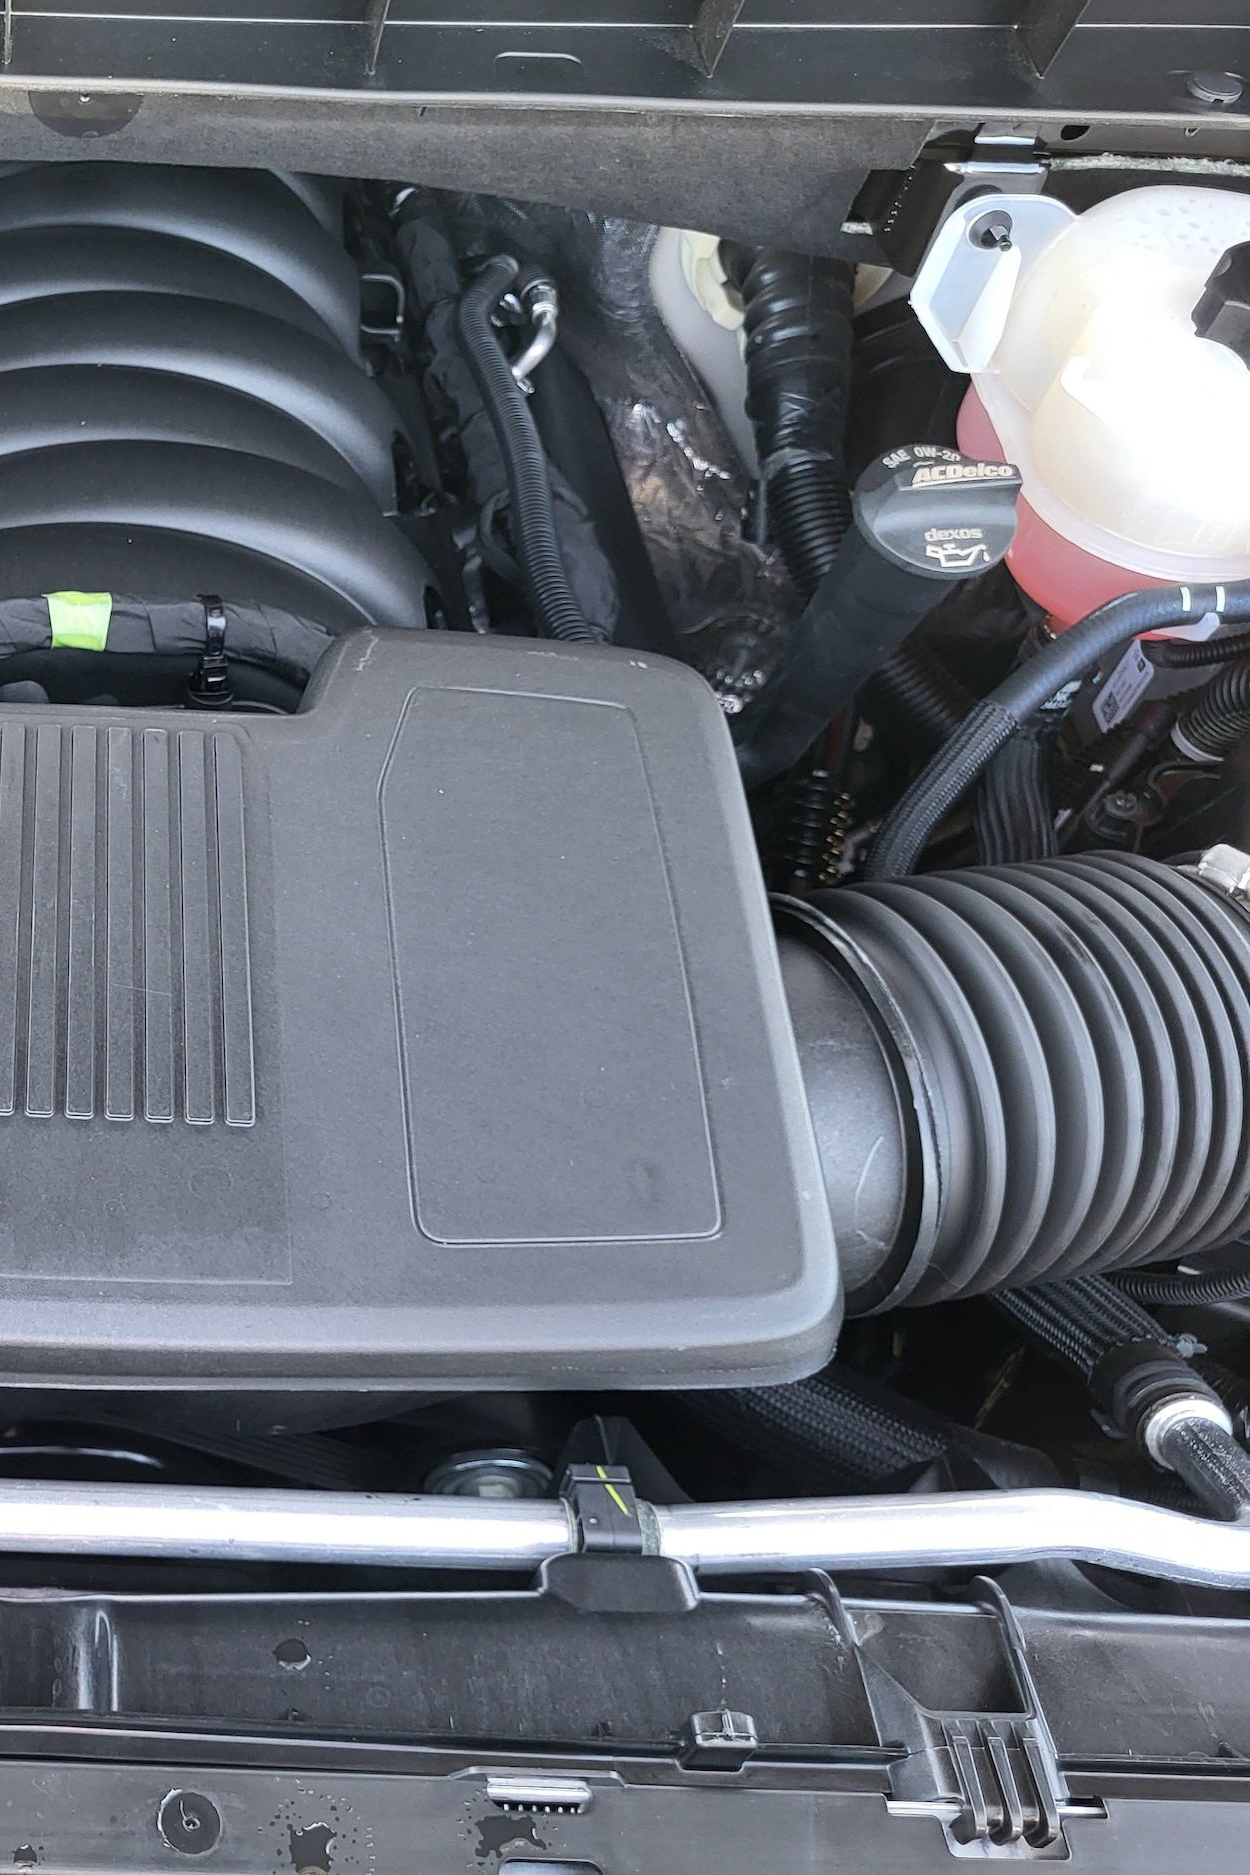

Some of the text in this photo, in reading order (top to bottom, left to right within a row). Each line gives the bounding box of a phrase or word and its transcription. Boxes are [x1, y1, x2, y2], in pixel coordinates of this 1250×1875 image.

[882, 449, 911, 468] SAE
[912, 463, 1013, 484] ACDelco
[924, 528, 983, 541] dexos
